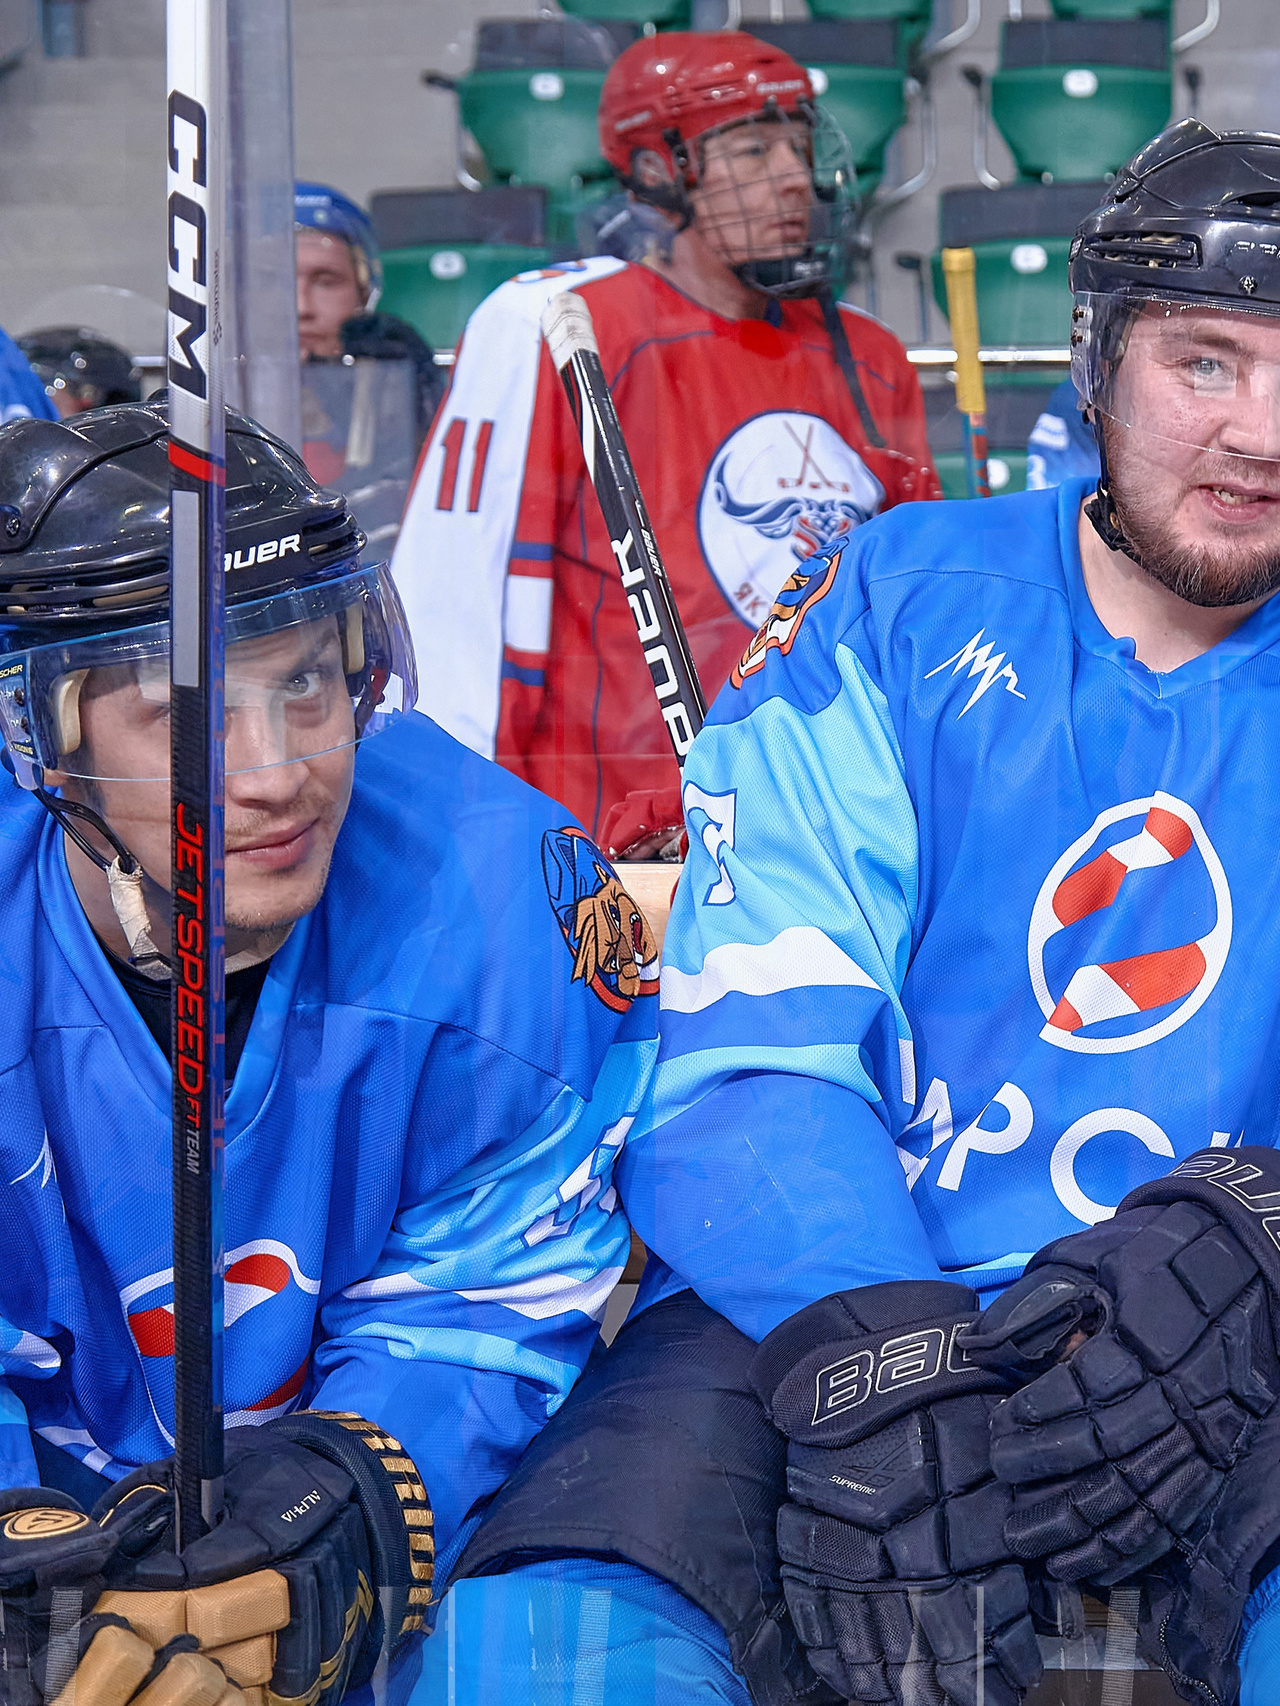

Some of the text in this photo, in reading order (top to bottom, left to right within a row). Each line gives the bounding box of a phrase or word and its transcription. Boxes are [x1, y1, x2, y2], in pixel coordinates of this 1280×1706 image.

[168, 89, 207, 400] CCM
[436, 417, 494, 513] 11
[224, 533, 300, 572] UER
[611, 528, 695, 758] AUER
[0, 664, 23, 678] SCHER
[176, 801, 204, 1095] JETSPEED
[185, 1128, 200, 1176] TEAM
[281, 1490, 322, 1523] ALPHA
[829, 1474, 877, 1496] SUPREME
